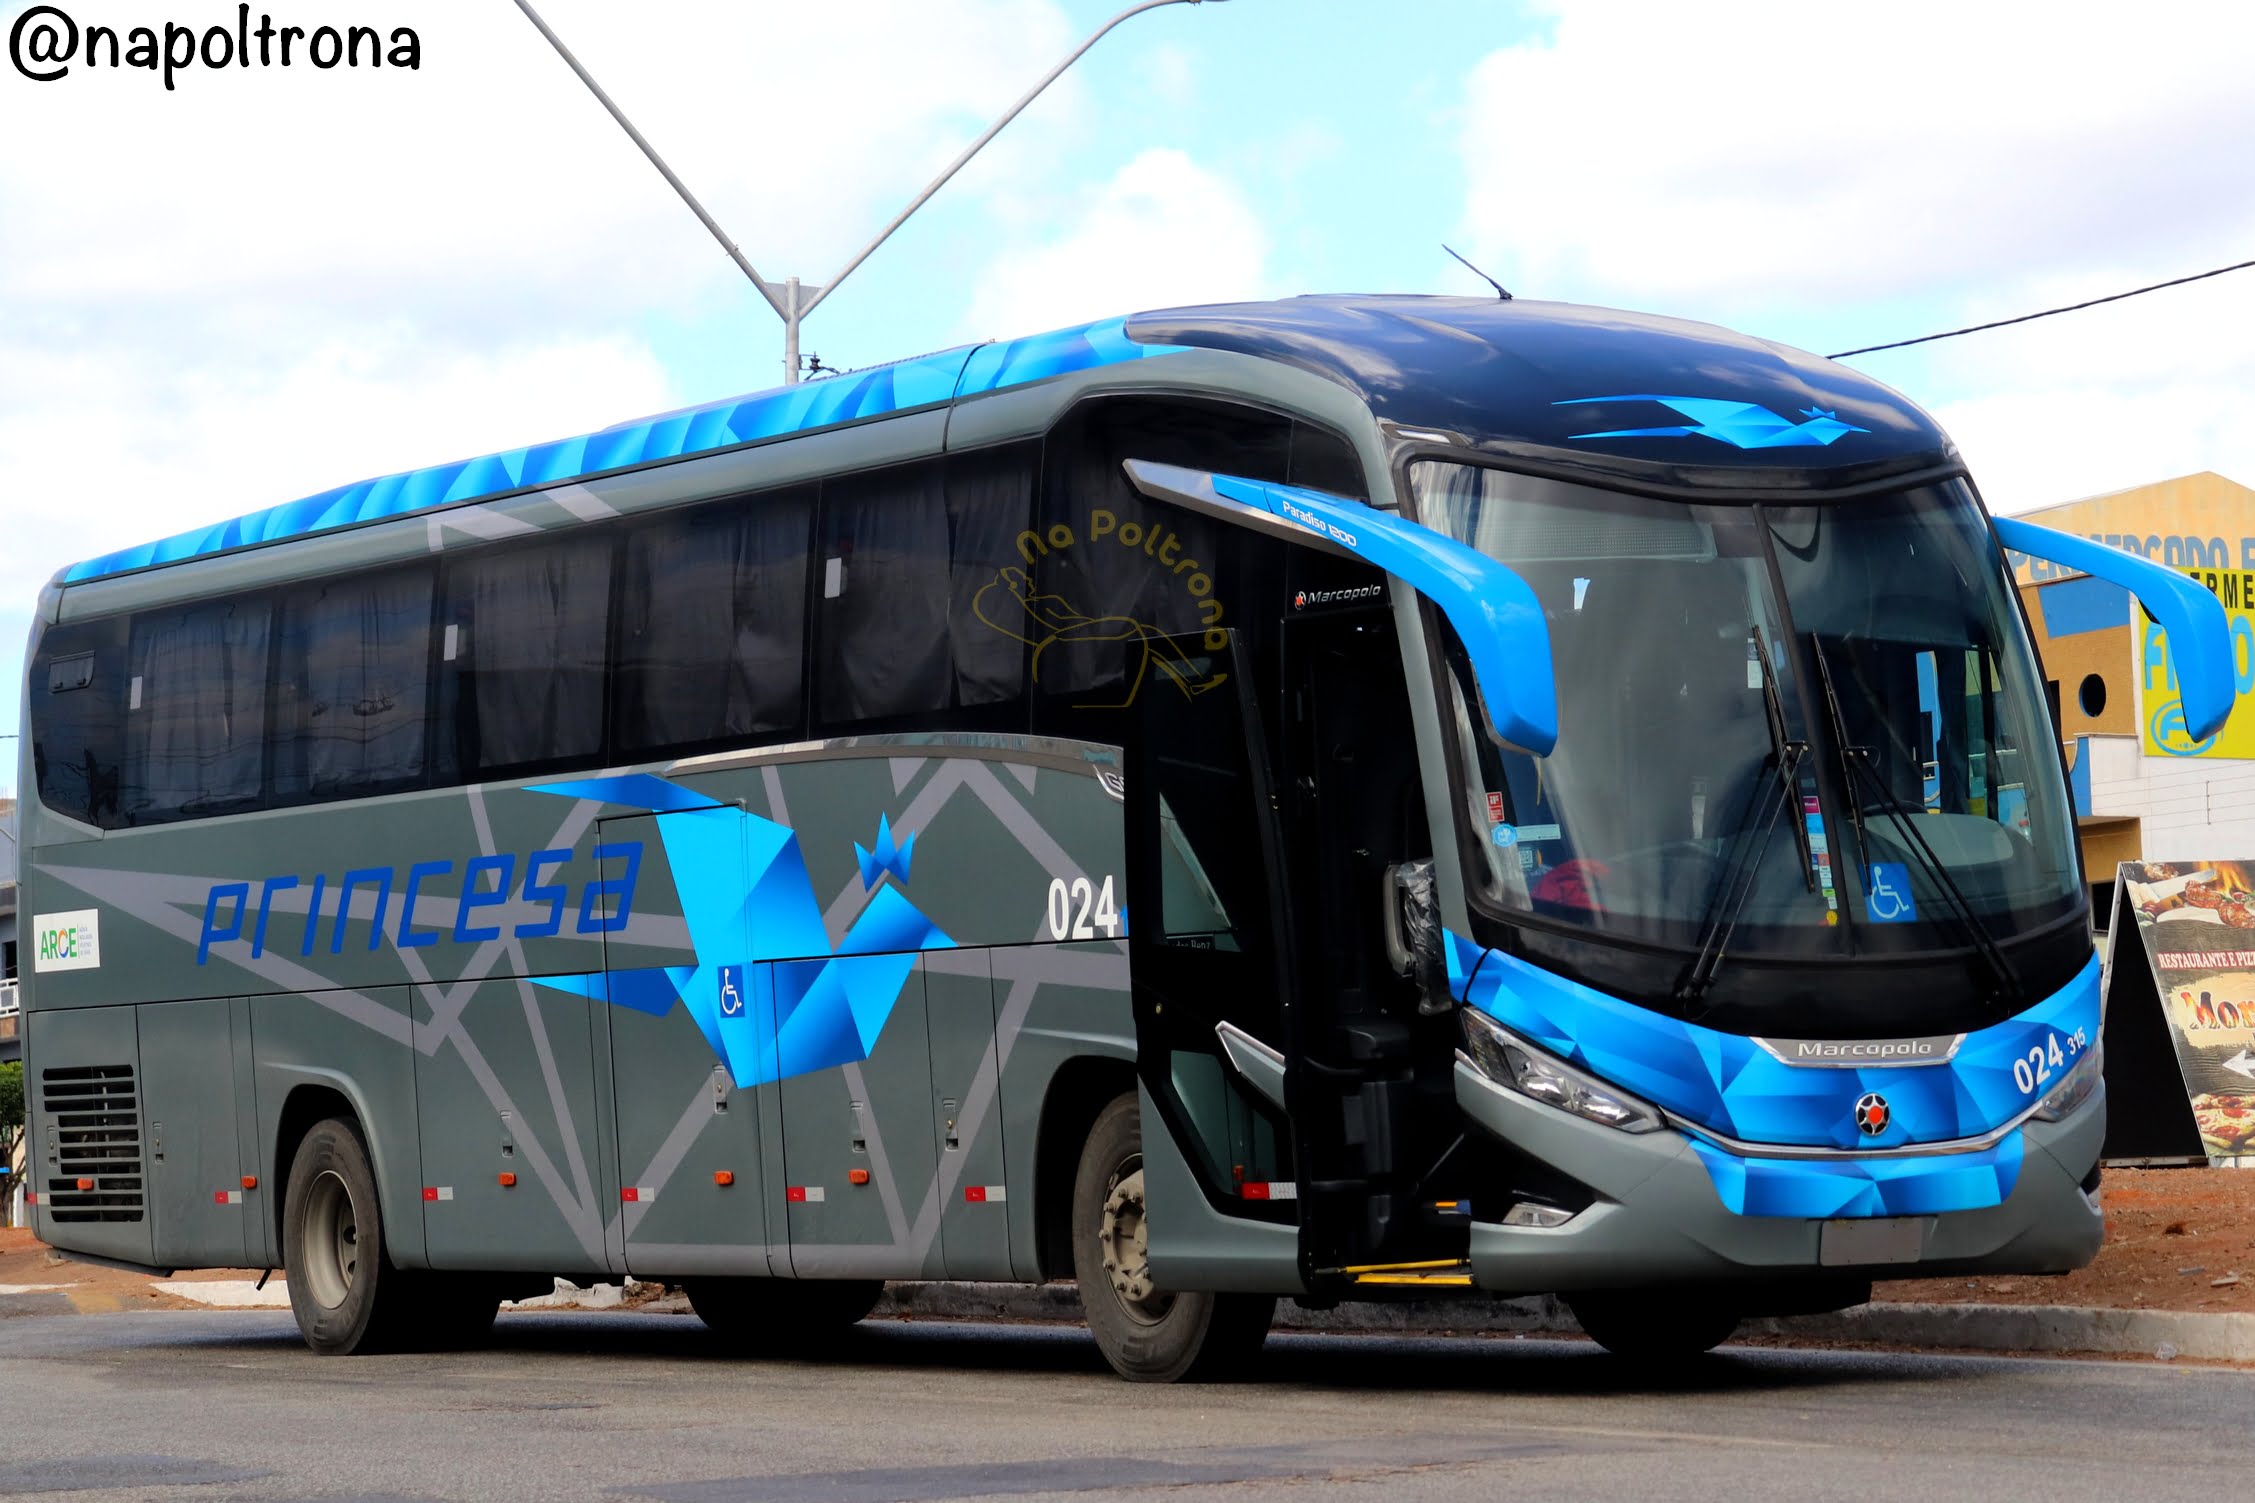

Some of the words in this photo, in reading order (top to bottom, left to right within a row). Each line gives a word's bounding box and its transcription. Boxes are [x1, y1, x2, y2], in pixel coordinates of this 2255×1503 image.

[1282, 501, 1326, 531] Paradiso
[1328, 523, 1357, 547] 1200
[1308, 584, 1381, 604] Marcopolo
[197, 842, 643, 966] princesa
[1047, 875, 1118, 941] 024
[40, 927, 78, 961] ARCE
[2158, 953, 2228, 968] RESTAURANTE
[2227, 952, 2236, 966] E
[1798, 1041, 1931, 1058] Marcopolo
[2013, 1032, 2064, 1094] 024
[2067, 1026, 2086, 1056] 315
